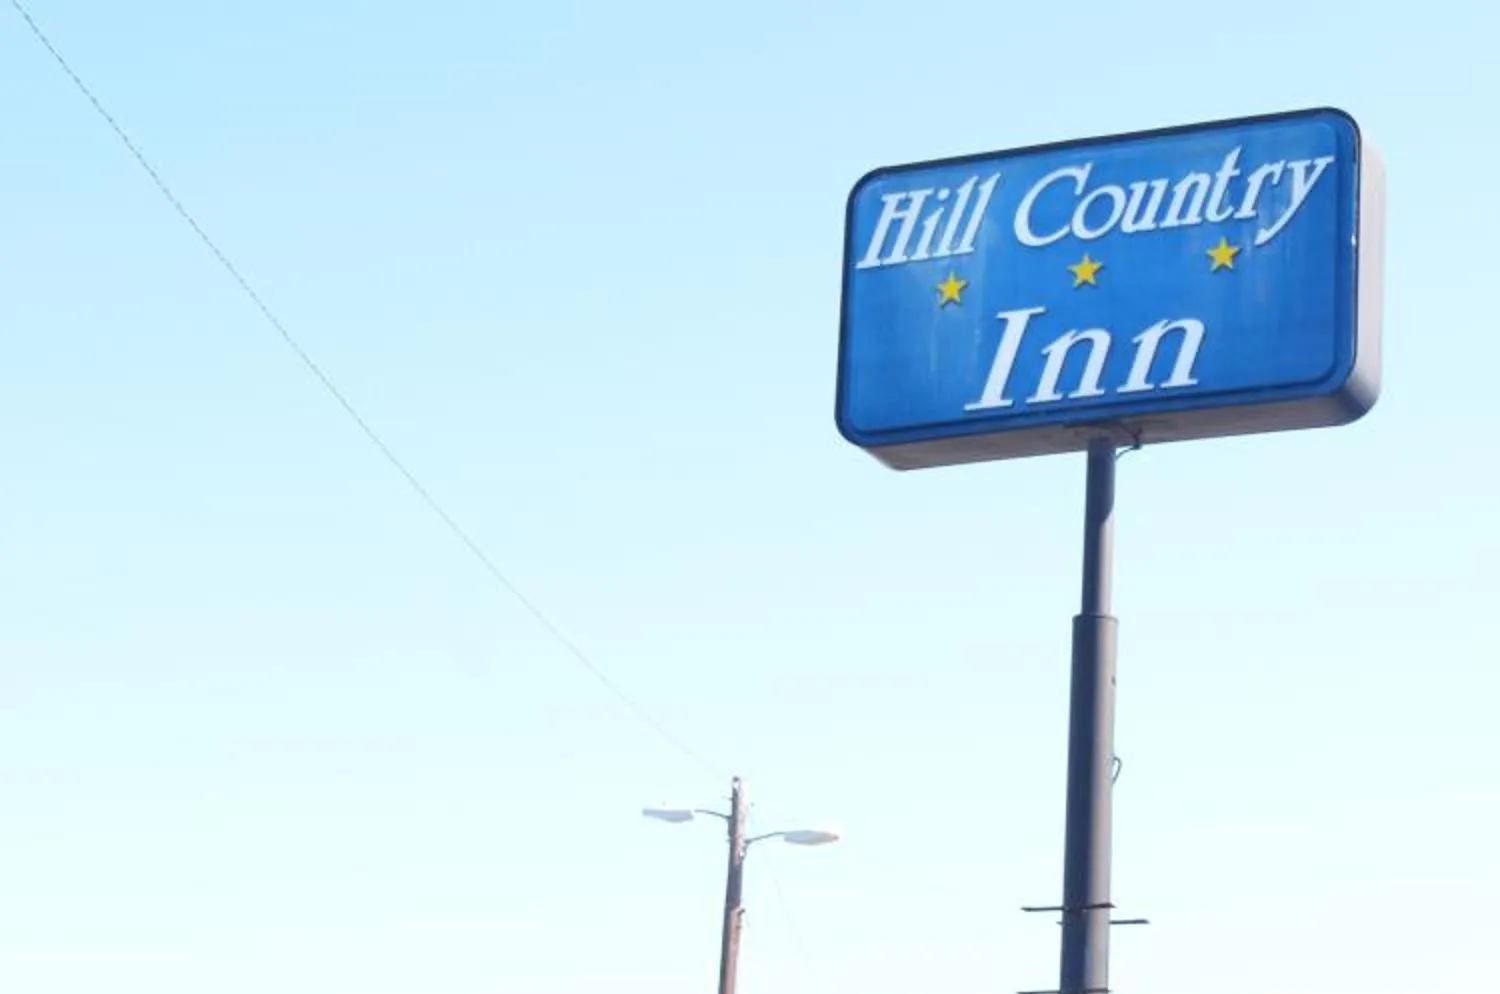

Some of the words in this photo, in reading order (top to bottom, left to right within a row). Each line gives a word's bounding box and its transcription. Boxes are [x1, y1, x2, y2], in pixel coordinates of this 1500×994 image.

[856, 171, 1001, 270] Hill
[1012, 144, 1335, 248] Country
[963, 305, 1206, 413] Inn
